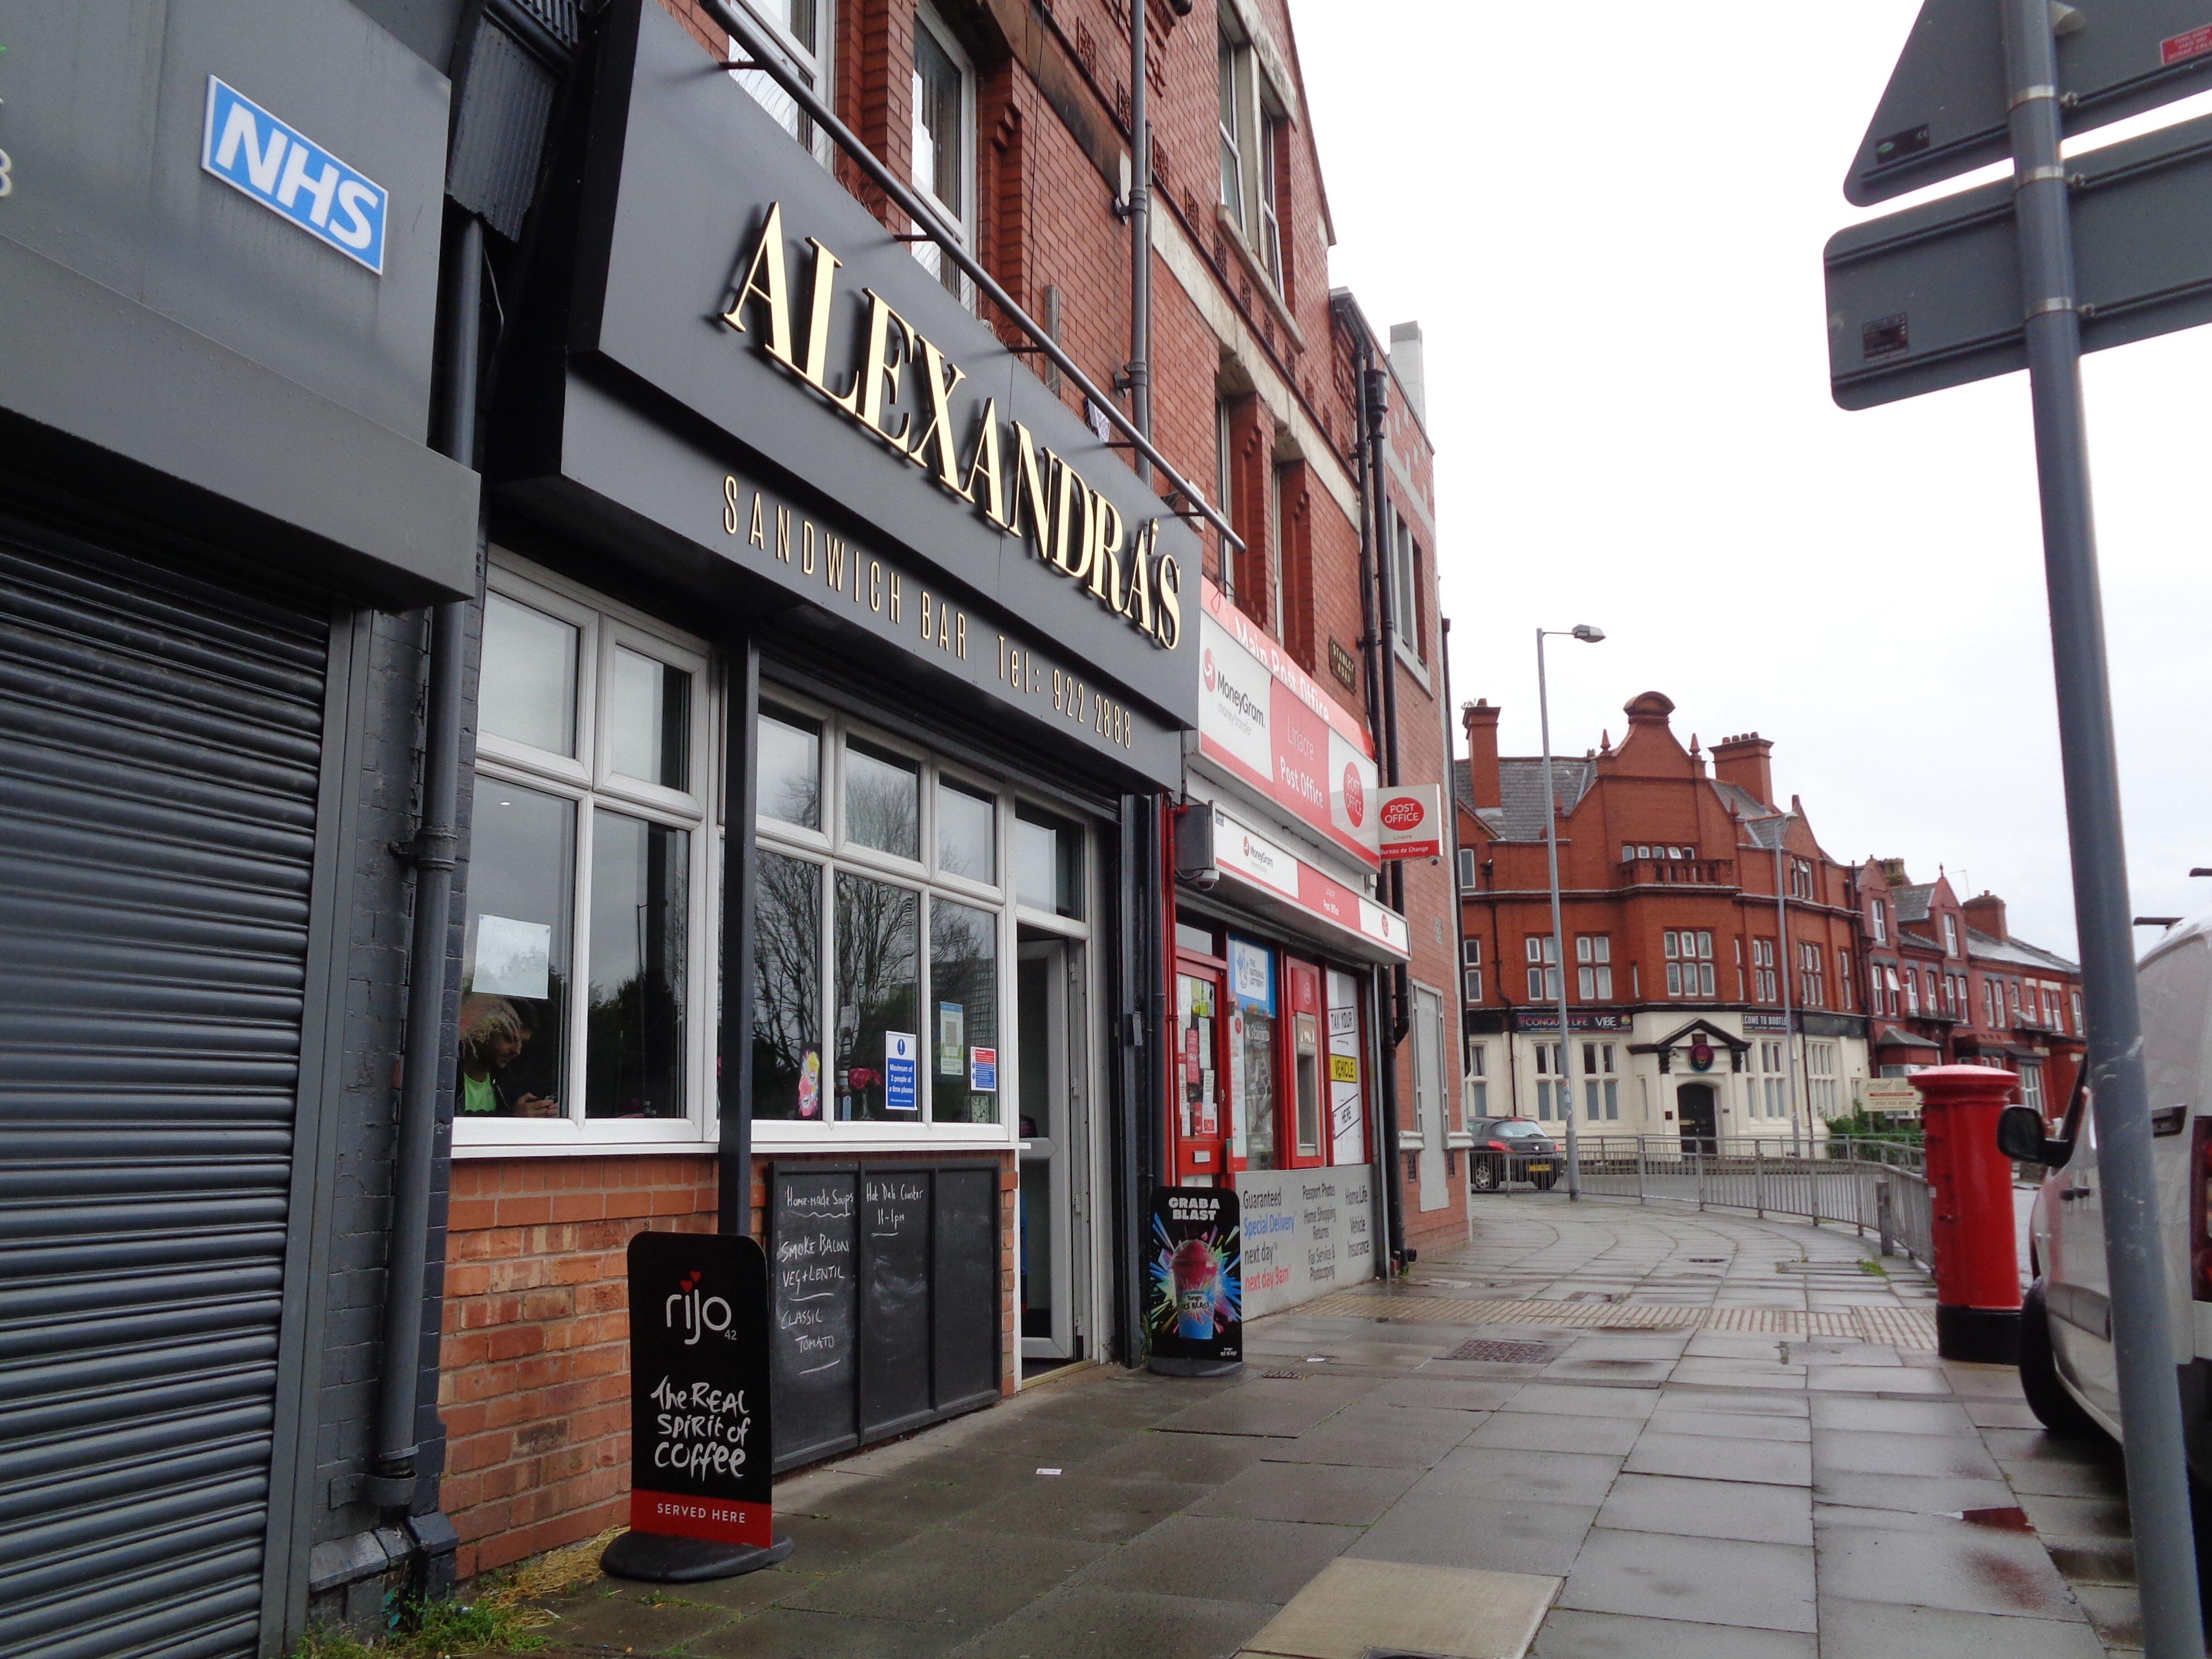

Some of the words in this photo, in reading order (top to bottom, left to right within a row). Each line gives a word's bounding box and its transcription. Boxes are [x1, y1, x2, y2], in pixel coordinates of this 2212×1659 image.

[215, 101, 378, 249] NHS
[717, 201, 1180, 650] ALEXANDRA'S
[724, 476, 900, 624] SANDWICH
[921, 591, 966, 660] BAR
[998, 635, 1039, 693] Tel:
[1053, 669, 1084, 723] 922
[1095, 694, 1130, 749] 2888
[1235, 615, 1268, 666] Main
[1271, 648, 1296, 690] Post
[1299, 676, 1329, 720] Office
[1333, 644, 1354, 673] STANLEY
[1288, 716, 1313, 761] Linacre
[1280, 755, 1299, 792] Post
[1300, 772, 1323, 810] Office
[1347, 774, 1360, 796] POST
[1346, 793, 1362, 816] OFFICE
[1390, 803, 1415, 813] POST
[1385, 812, 1419, 823] OFFICE
[1526, 1018, 1570, 1026] CONQU
[1572, 1018, 1588, 1026] LIFE
[1595, 1017, 1616, 1027] VIBE
[867, 1182, 879, 1202] Hot
[1169, 1197, 1208, 1209] GRAB
[1209, 1198, 1220, 1209] A
[1243, 1186, 1281, 1209] Guaranteed
[1173, 1209, 1217, 1220] BLAST
[1244, 1213, 1268, 1241] Special
[782, 1235, 816, 1263] SMOKE
[820, 1233, 850, 1256] BACON
[1245, 1244, 1260, 1265] next
[1245, 1271, 1260, 1292] next
[1262, 1268, 1274, 1291] day
[666, 1289, 732, 1345] rijo
[724, 1329, 737, 1341] 42
[781, 1308, 822, 1329] CLASSIC
[795, 1335, 834, 1353] TOMATO
[650, 1375, 687, 1411] The
[727, 1417, 751, 1447] of
[658, 1503, 706, 1519] SERVED
[712, 1509, 746, 1524] HERE
